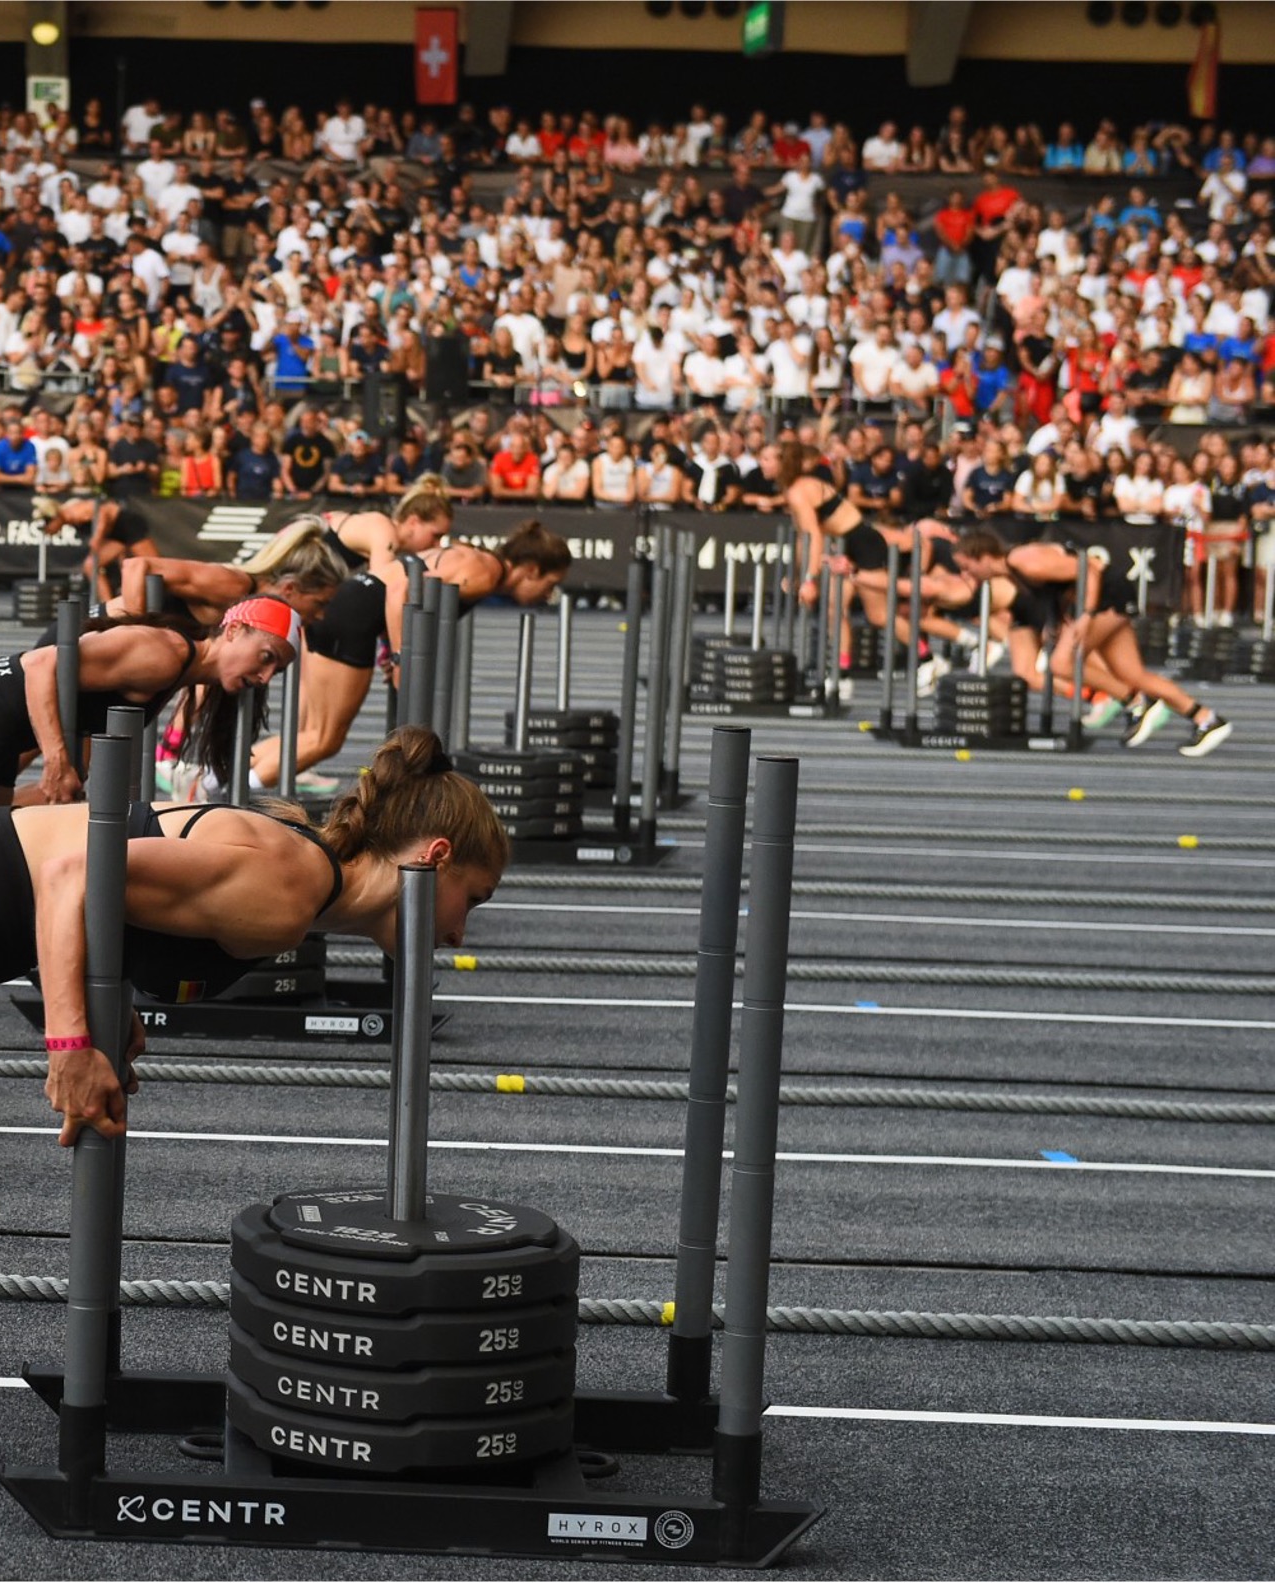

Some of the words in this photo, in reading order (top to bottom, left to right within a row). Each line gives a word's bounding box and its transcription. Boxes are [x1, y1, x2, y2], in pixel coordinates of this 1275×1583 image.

[479, 763, 523, 776] CENTR
[275, 1269, 377, 1304] CENTR
[273, 1321, 373, 1357] CENTR
[277, 1376, 381, 1411] CENTR
[271, 1425, 372, 1463] CENTR
[151, 1498, 286, 1526] CENTR
[558, 1519, 638, 1534] HYROX
